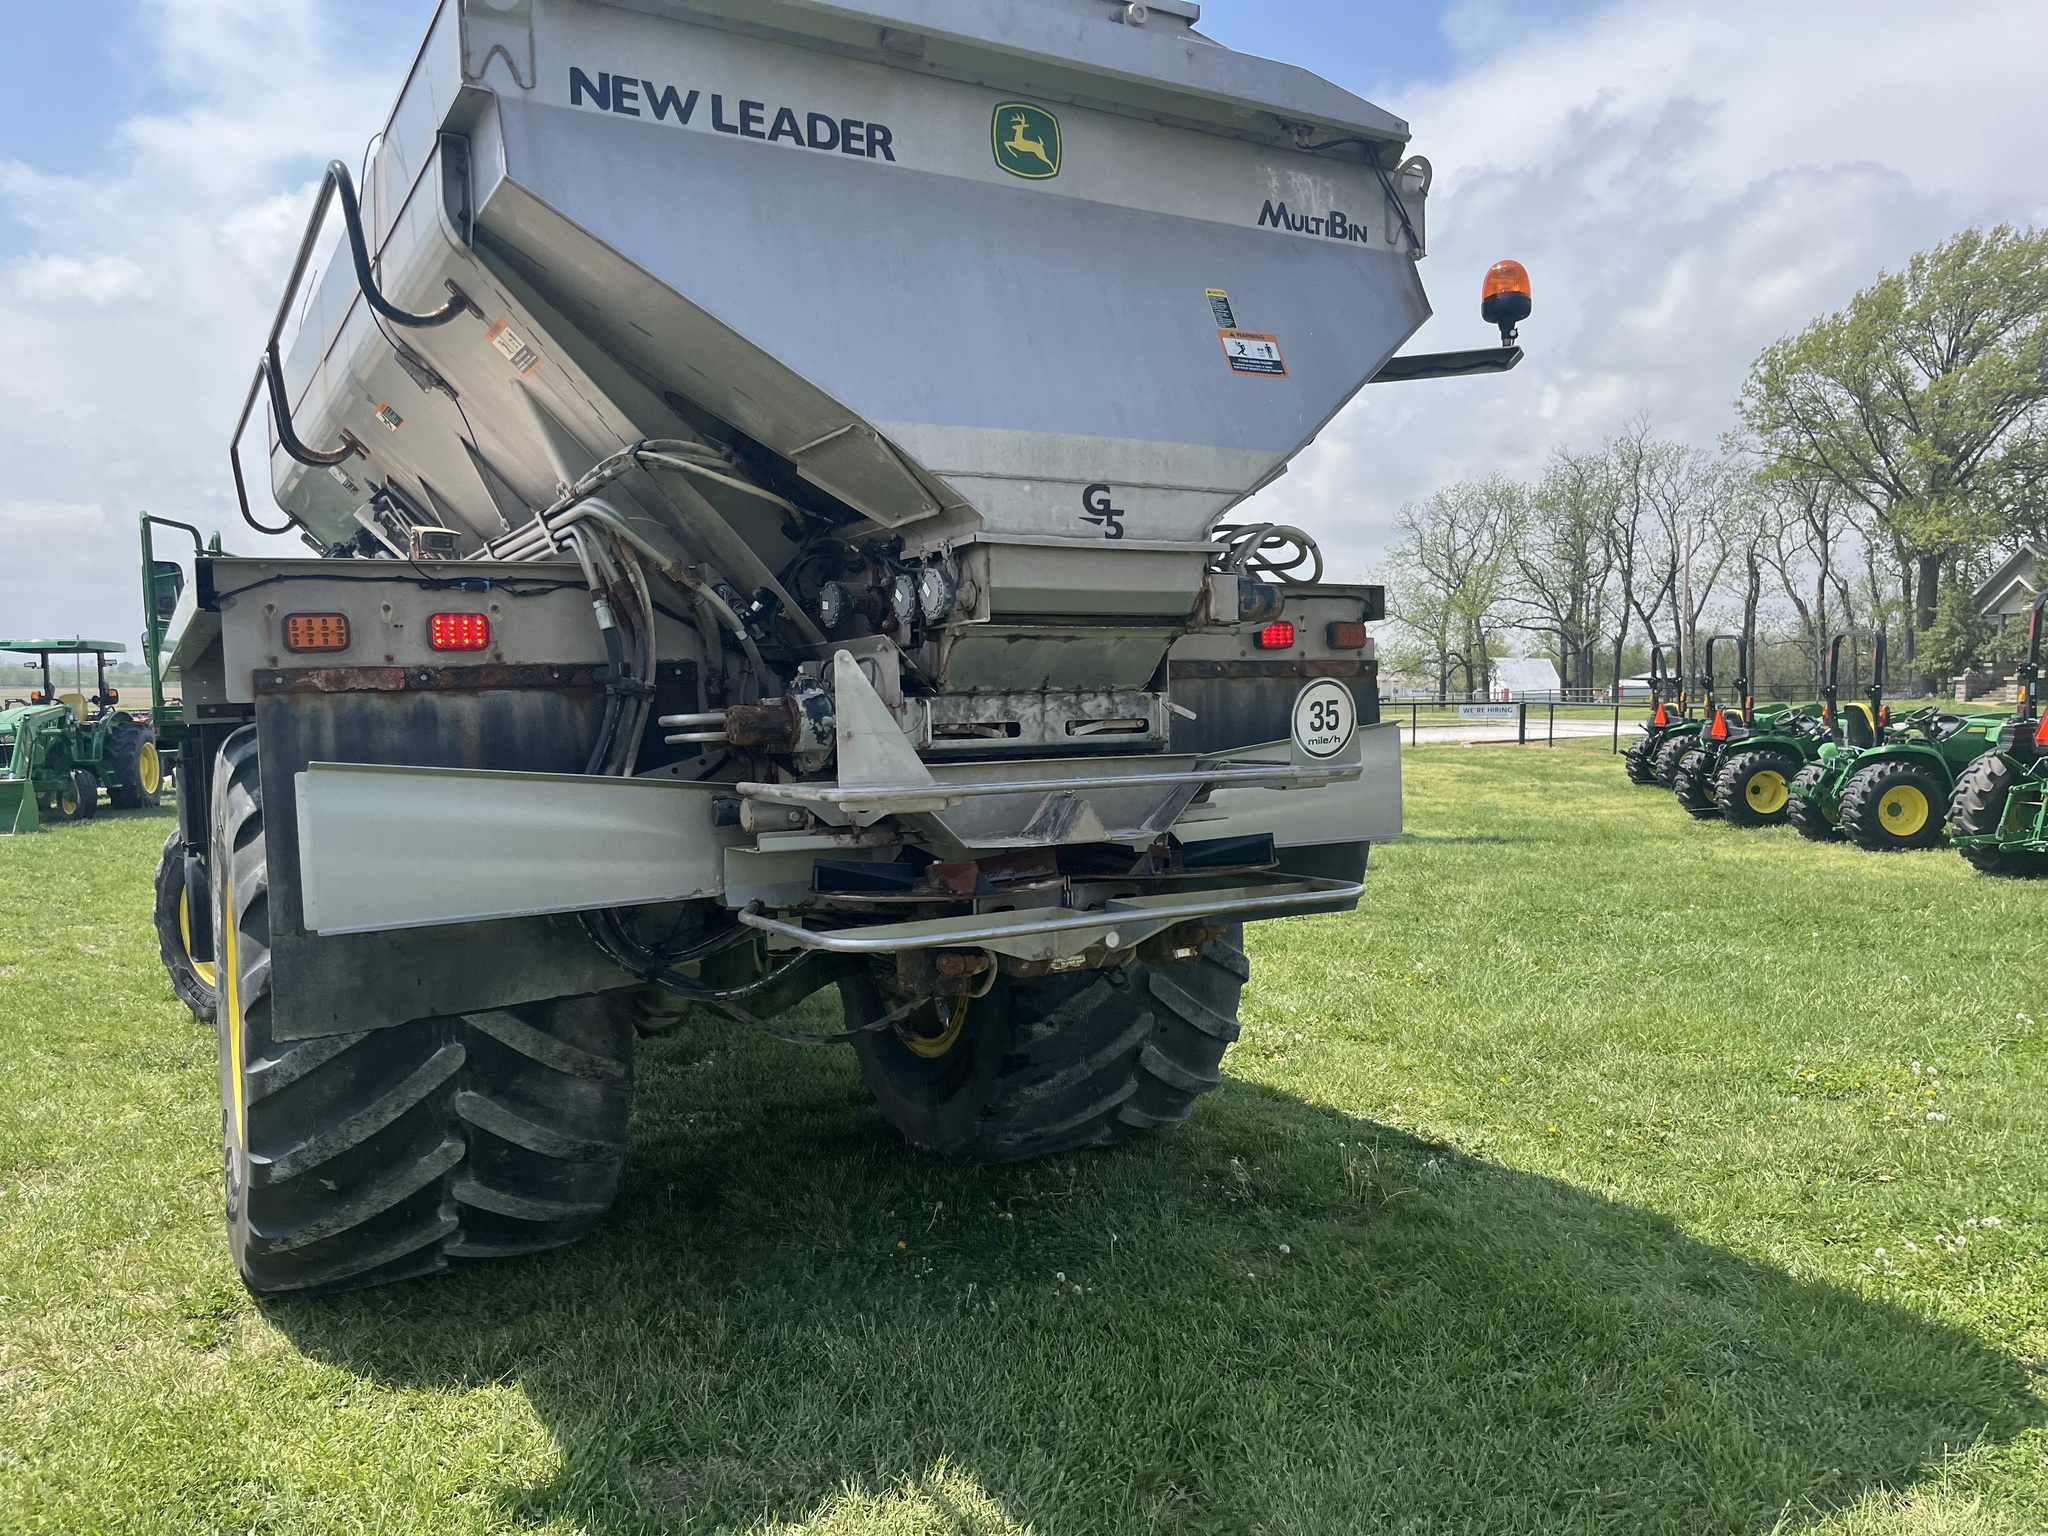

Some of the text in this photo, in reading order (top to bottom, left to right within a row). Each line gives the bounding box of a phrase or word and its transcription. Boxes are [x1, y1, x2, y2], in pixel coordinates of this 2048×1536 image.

[569, 66, 896, 162] NEW LEADER
[1236, 331, 1265, 341] WARNING
[1309, 699, 1340, 732] 35
[1462, 705, 1513, 714] WE'RE HIRING
[1308, 734, 1341, 746] mile/h
